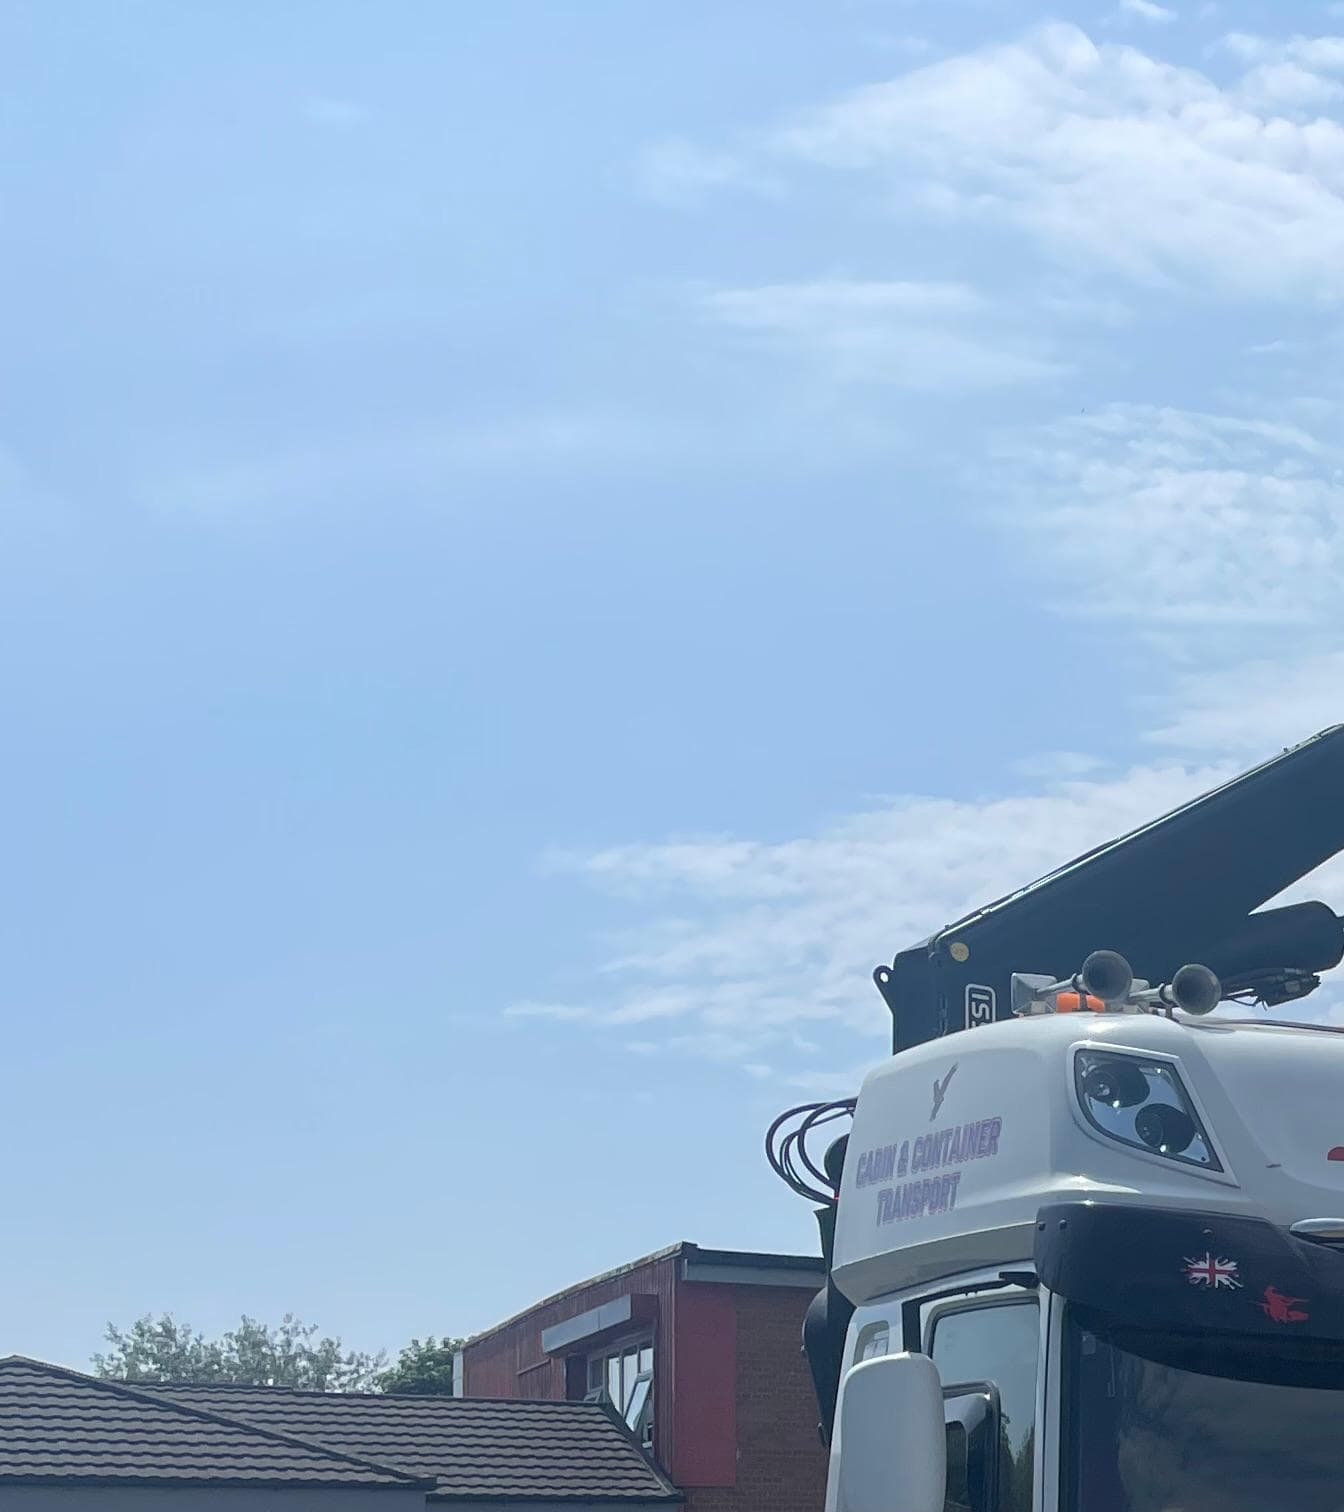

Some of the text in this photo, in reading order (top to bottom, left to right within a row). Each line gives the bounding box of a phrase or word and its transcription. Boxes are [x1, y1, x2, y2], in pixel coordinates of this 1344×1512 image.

[855, 1116, 1002, 1189] CABIN & CONTAINER
[876, 1171, 961, 1228] TRANSPORT
